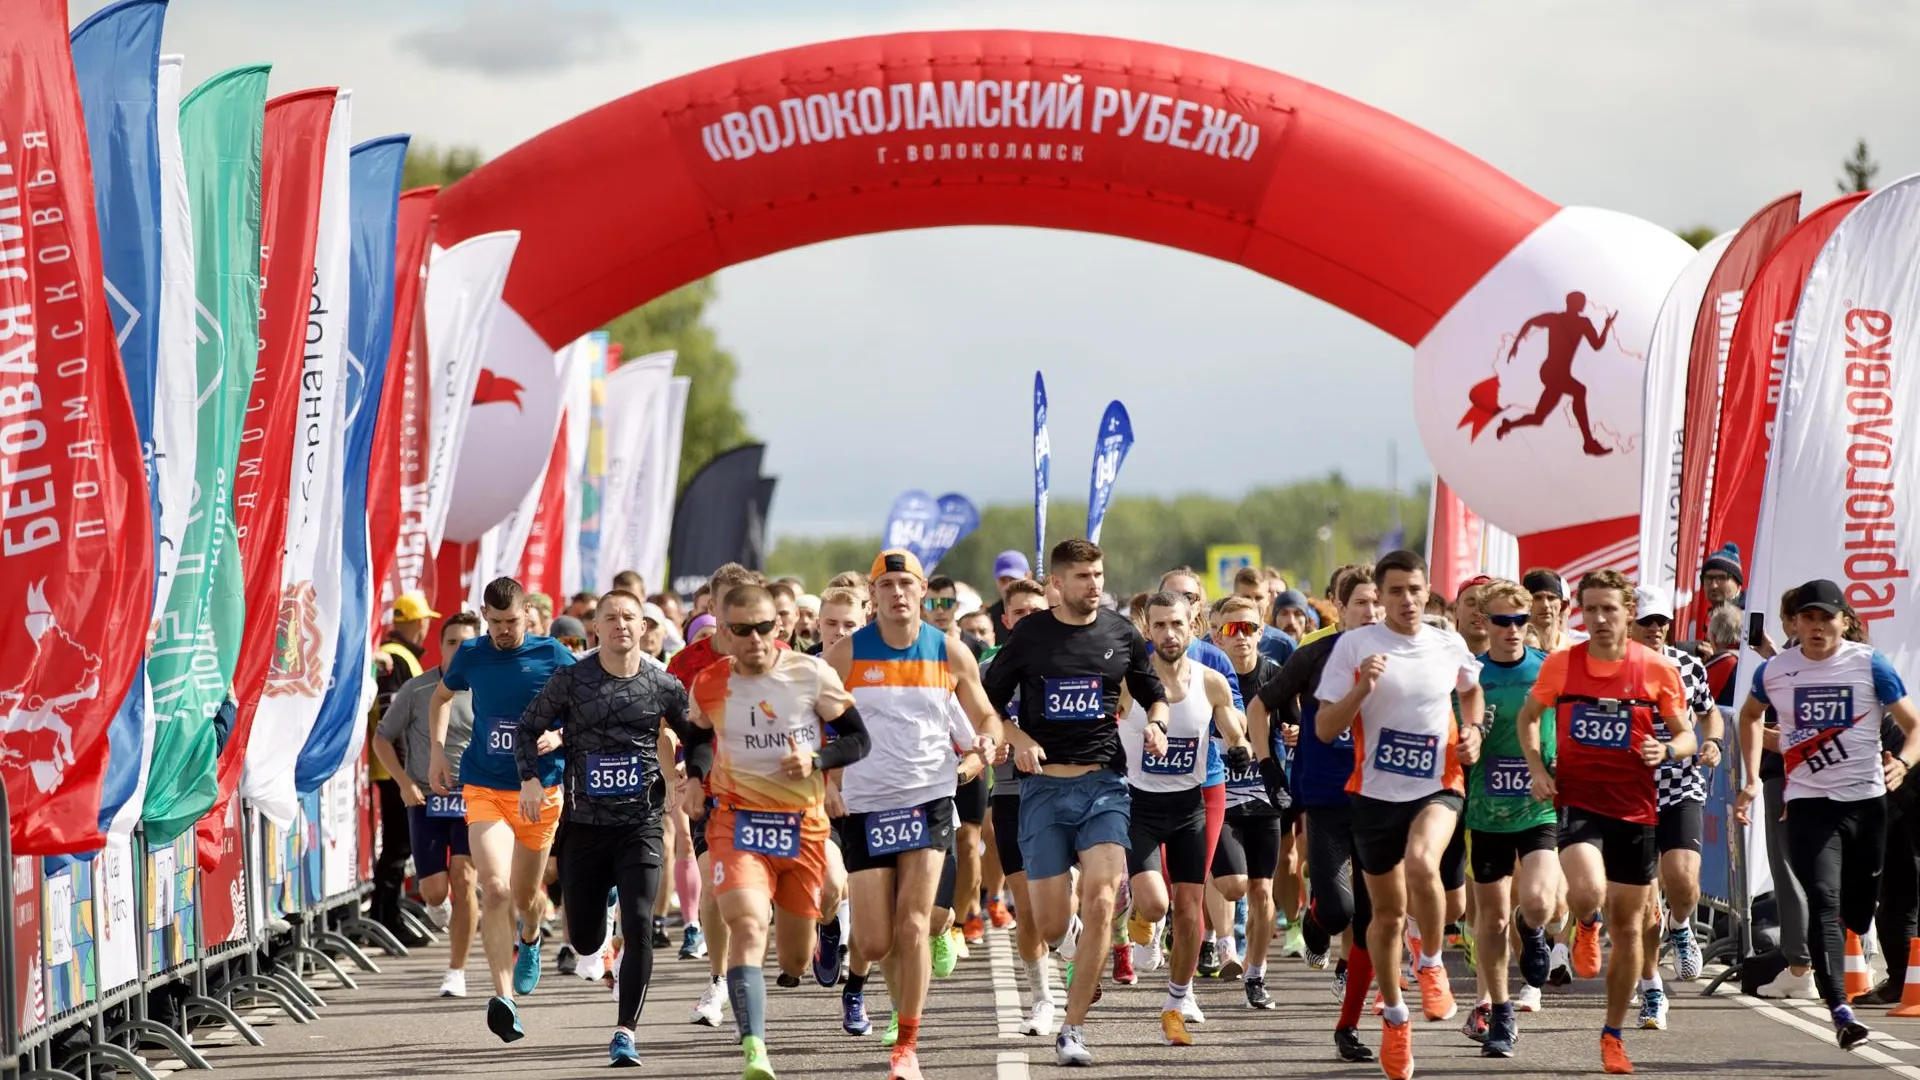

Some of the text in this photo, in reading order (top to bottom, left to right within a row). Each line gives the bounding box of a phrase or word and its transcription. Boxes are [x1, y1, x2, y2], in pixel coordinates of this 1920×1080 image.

[702, 73, 1260, 162] «ВОЛОКОЛАМСКИЙ РУБЕЖ»
[907, 142, 1085, 163] ВОЛОКОЛАМСК
[23, 130, 106, 539] ПОДМОСКОВЬЯ
[1048, 692, 1100, 713] 3464
[1800, 701, 1846, 721] 3571
[490, 731, 512, 750] 30
[744, 725, 816, 750] RUNNERS
[1574, 719, 1627, 741] 3369
[1378, 744, 1434, 771] 3358
[590, 767, 638, 788] 3586
[1491, 771, 1534, 790] 3162
[741, 826, 793, 850] 3135
[871, 821, 923, 848] 3349
